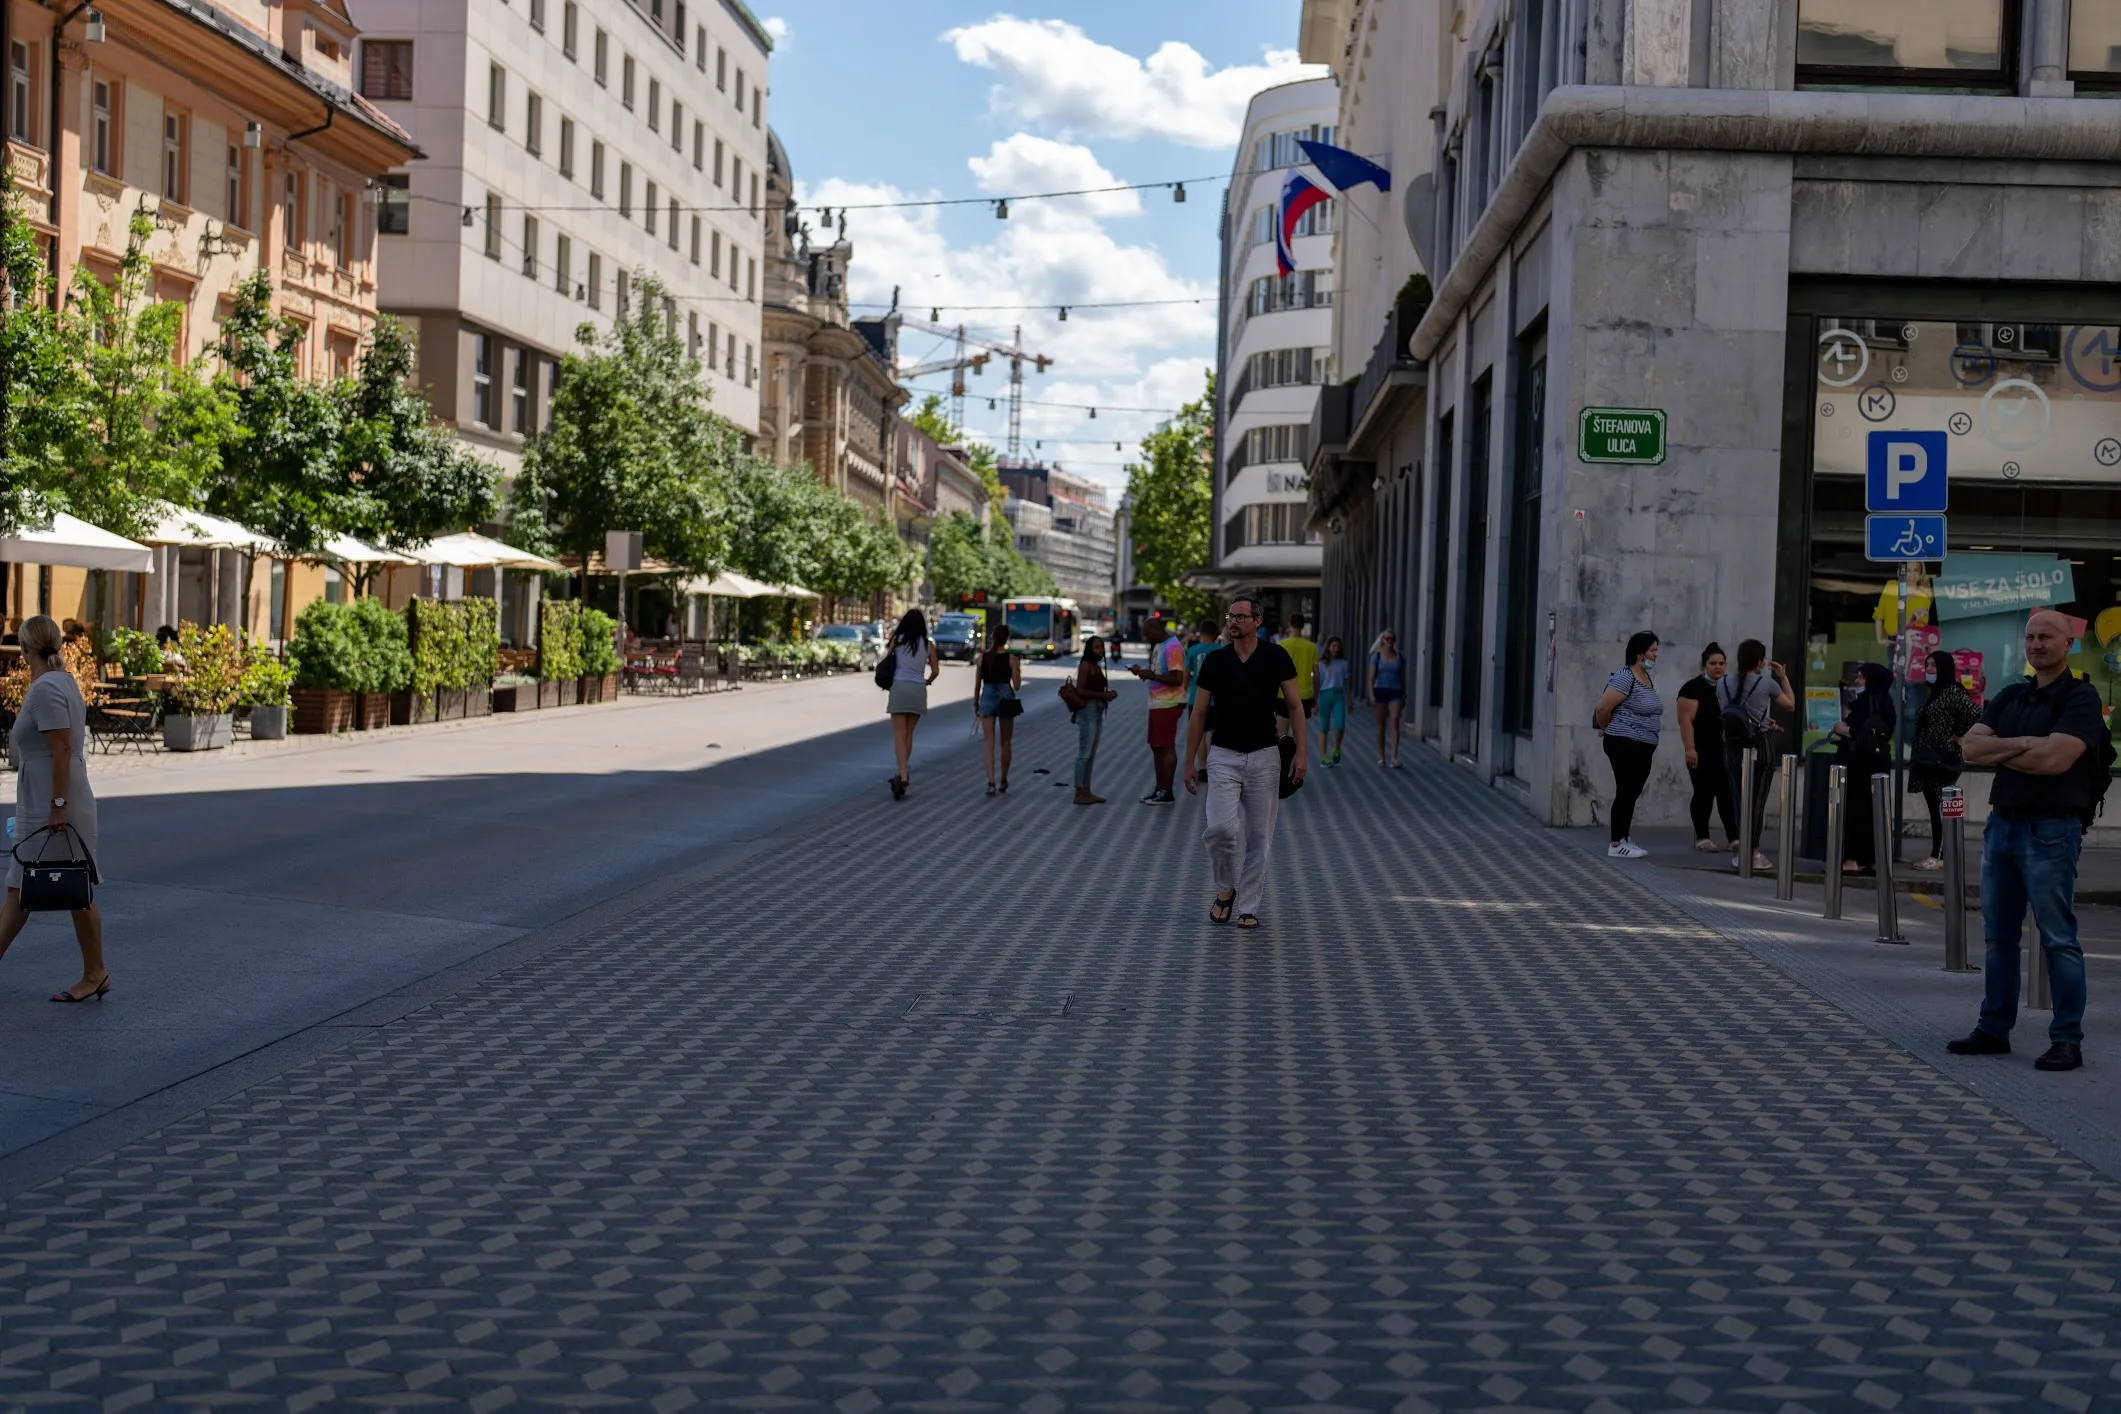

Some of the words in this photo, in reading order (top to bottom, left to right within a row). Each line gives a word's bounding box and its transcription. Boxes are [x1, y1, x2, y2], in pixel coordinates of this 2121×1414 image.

[1593, 415, 1652, 434] ŠTEFANOVA
[1607, 438, 1636, 453] ULICA
[1886, 442, 1928, 500] P
[1944, 581, 1980, 600] VSE
[1984, 576, 2011, 594] ZA
[2015, 569, 2064, 589] ŠOLO
[1943, 800, 1963, 808] STOP
